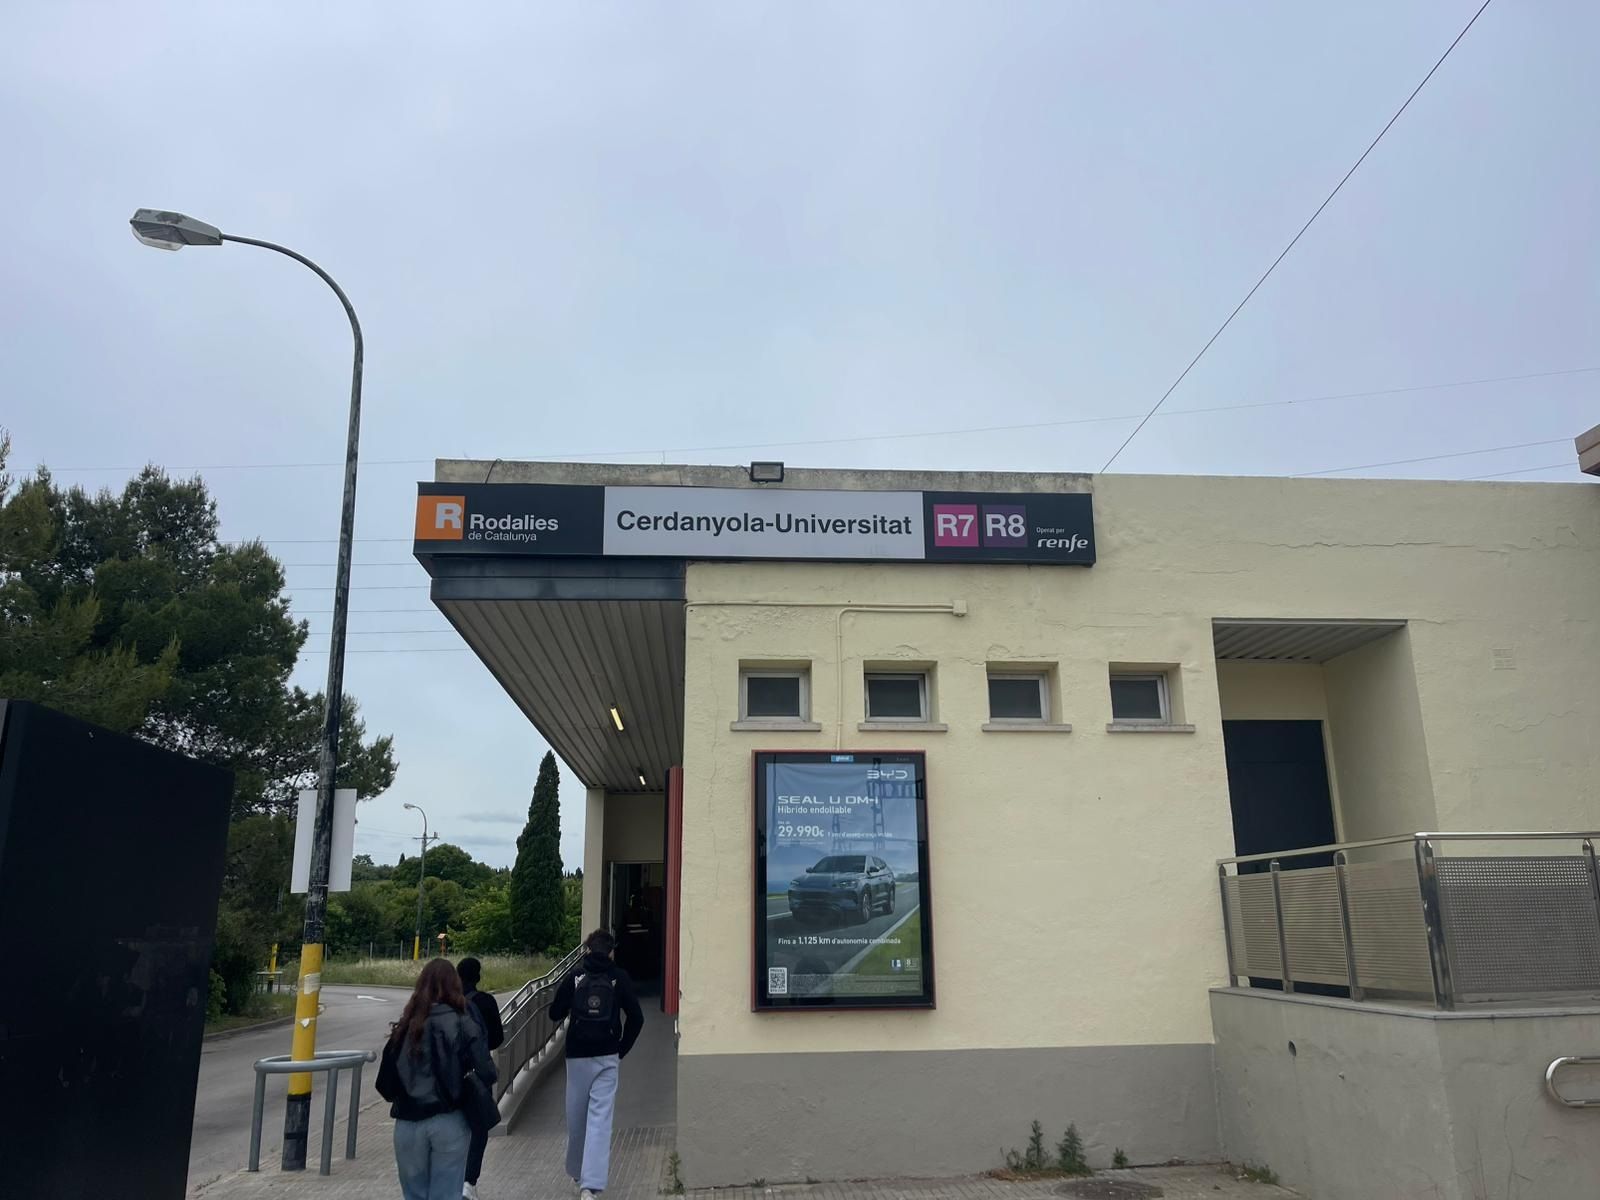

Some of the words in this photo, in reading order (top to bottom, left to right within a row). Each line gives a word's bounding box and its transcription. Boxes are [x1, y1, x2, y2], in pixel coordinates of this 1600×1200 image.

[434, 502, 462, 529] R
[469, 514, 559, 531] Rodalies
[616, 510, 913, 537] Cerdanyola-Universitat
[936, 514, 975, 537] R7
[985, 514, 1025, 537] R8
[468, 531, 482, 541] de
[484, 531, 537, 542] Catalunya
[1037, 533, 1088, 553] renfe
[867, 769, 908, 779] BYD
[777, 795, 824, 804] SEAL
[829, 795, 840, 804] U
[809, 805, 852, 814] endollable
[777, 937, 791, 945] Fins
[798, 936, 818, 945] 1.125
[818, 936, 831, 945] km
